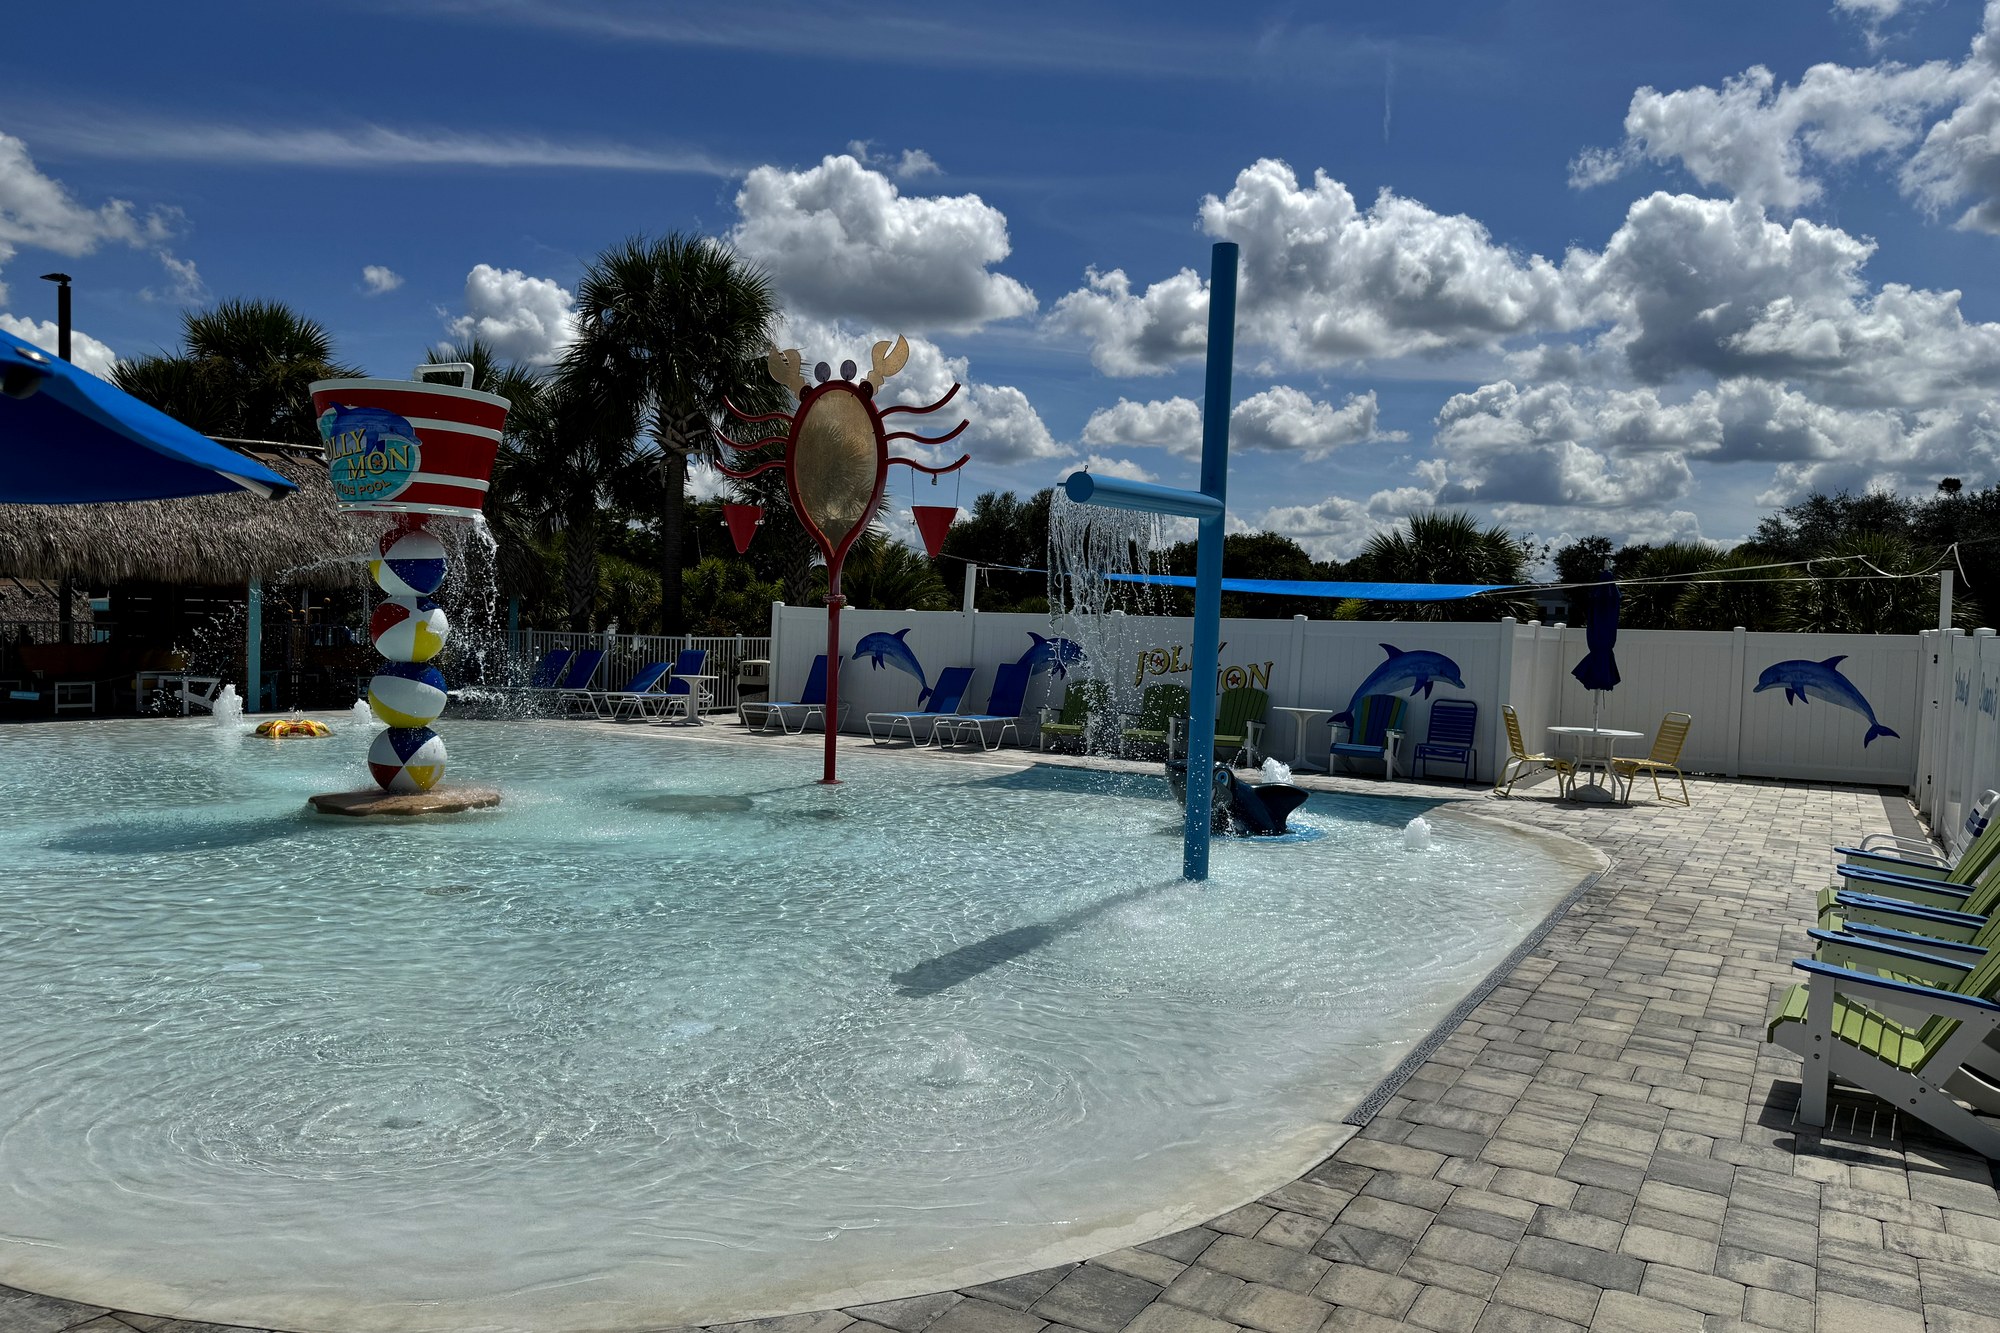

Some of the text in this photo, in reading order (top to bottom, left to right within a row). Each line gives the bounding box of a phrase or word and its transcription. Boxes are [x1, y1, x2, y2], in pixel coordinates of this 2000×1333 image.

[324, 428, 367, 461] OLLY
[347, 445, 410, 480] MON
[359, 480, 392, 496] POOL
[1134, 641, 1228, 688] JOL
[1216, 661, 1274, 696] ON
